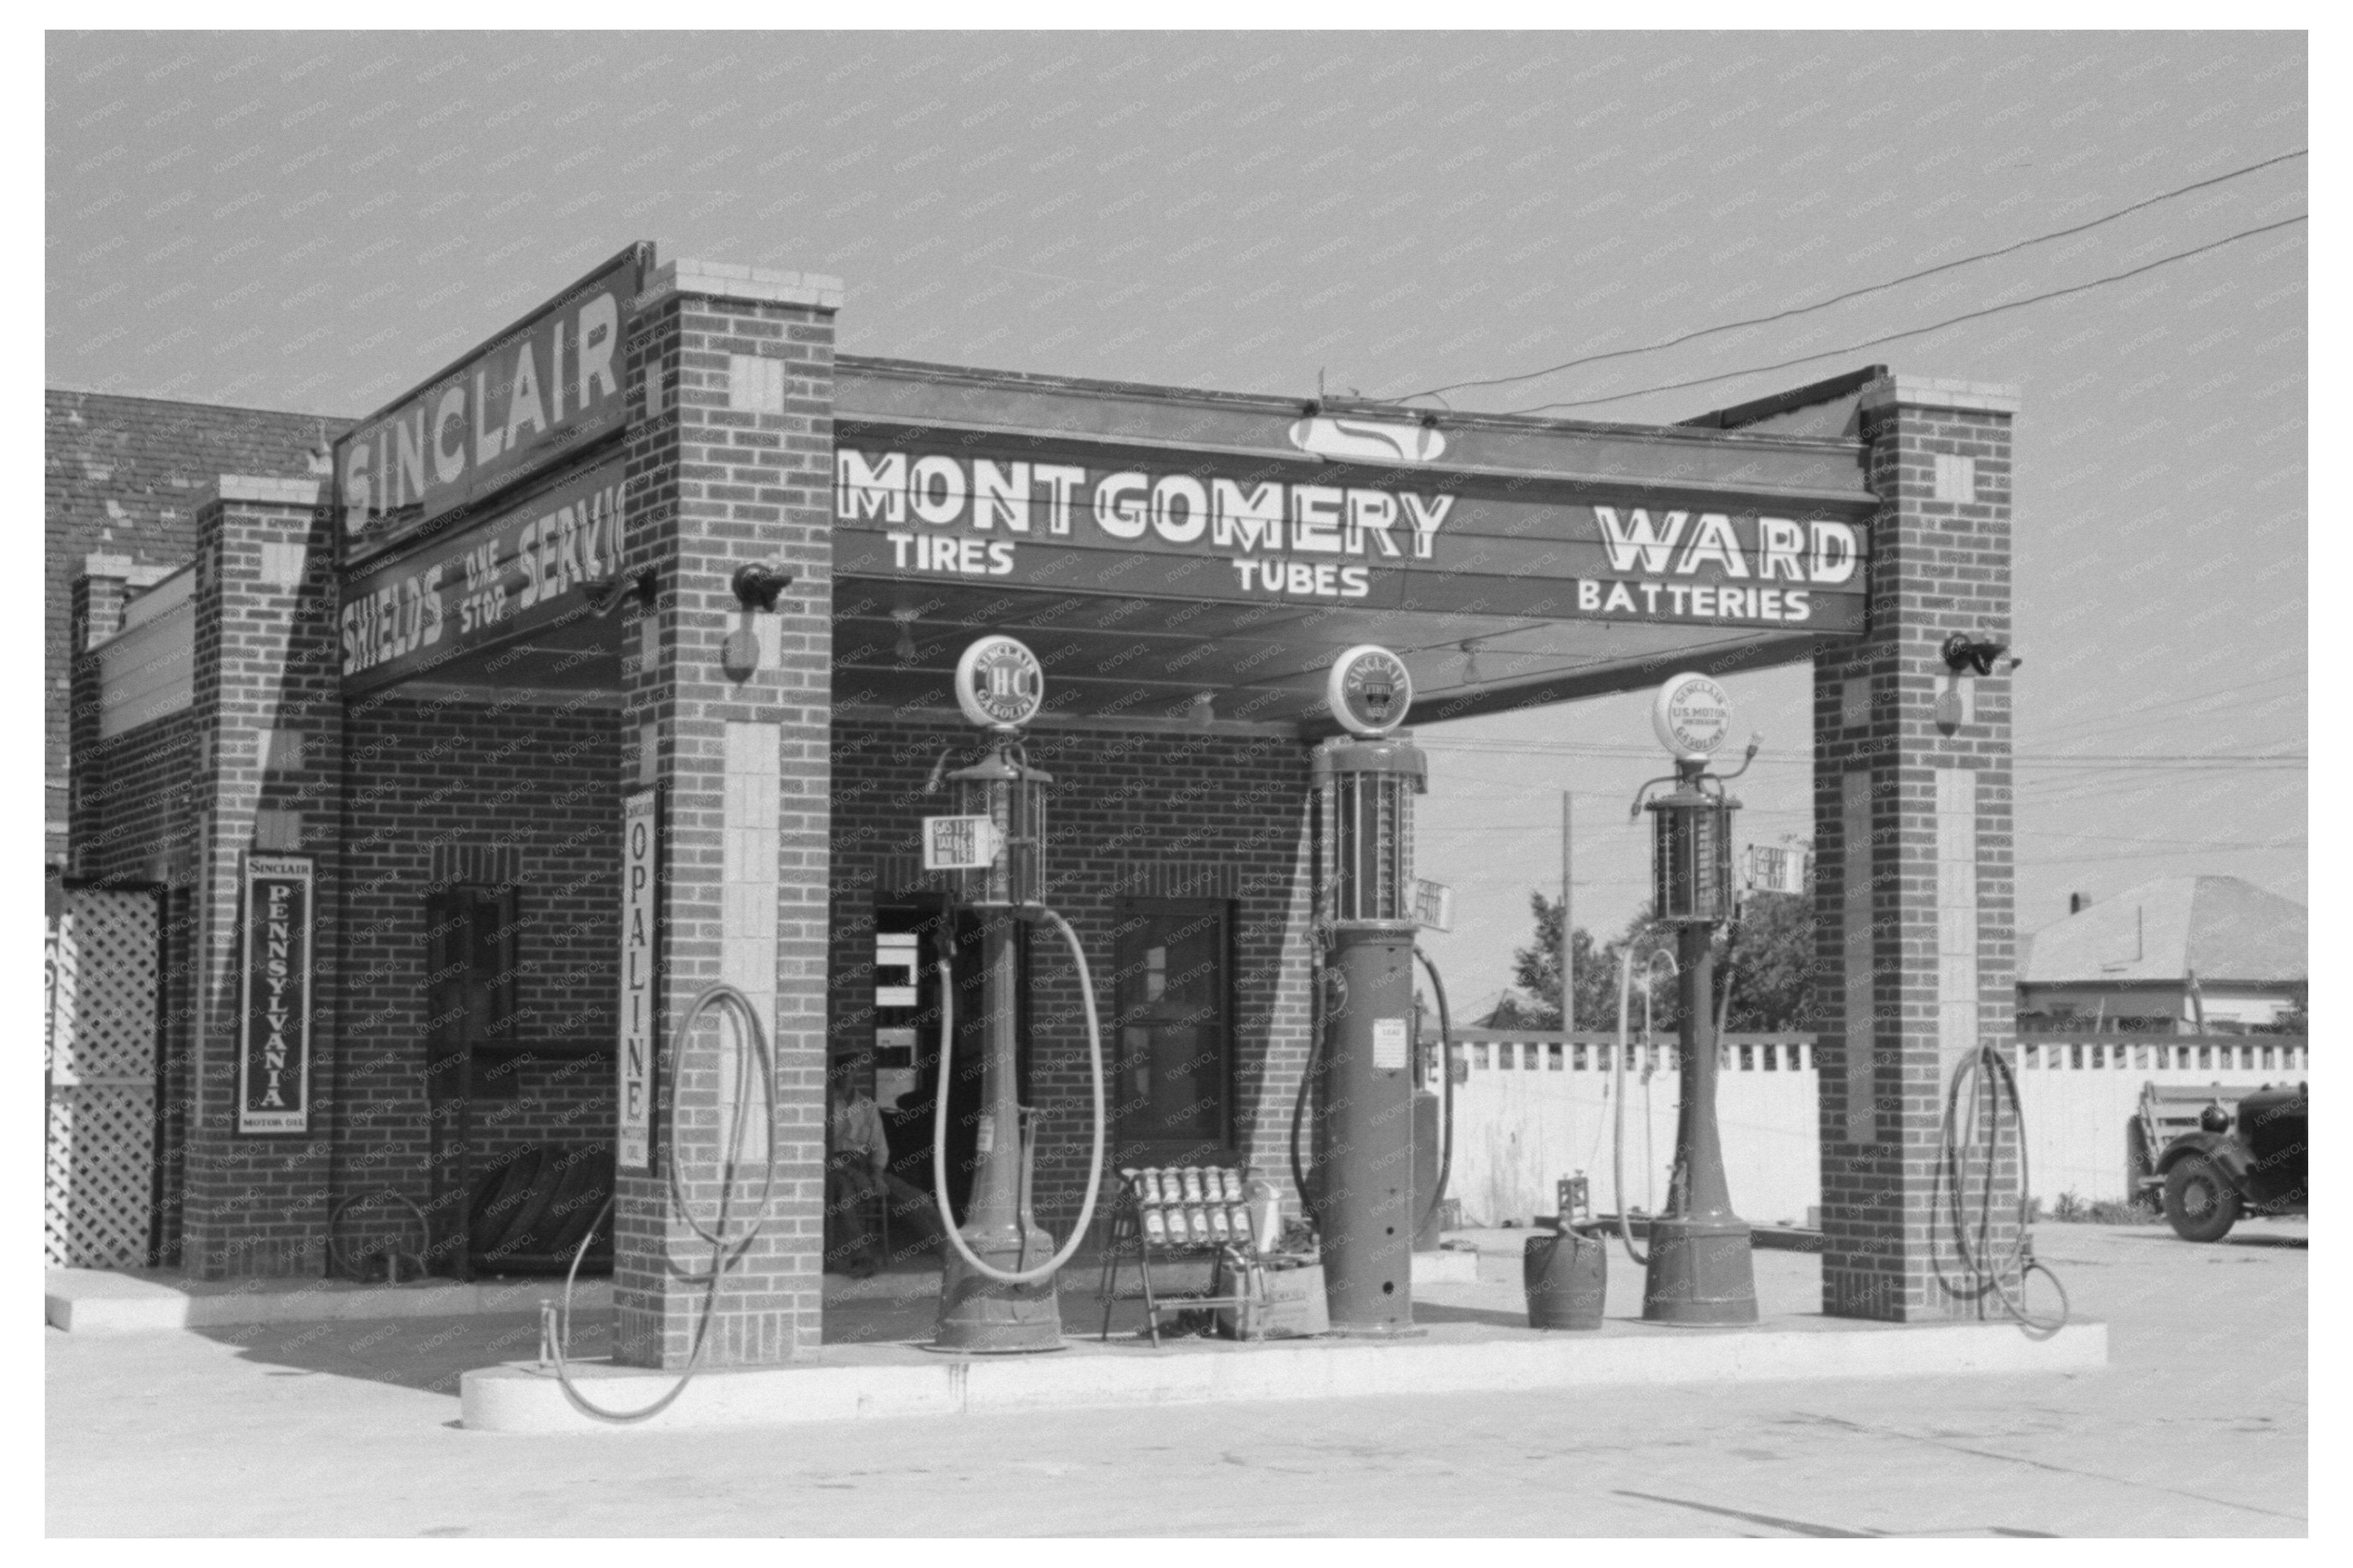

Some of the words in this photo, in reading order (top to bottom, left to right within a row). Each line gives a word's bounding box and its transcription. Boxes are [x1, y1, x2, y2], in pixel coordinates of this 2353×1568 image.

[346, 291, 618, 534] SINCLAIR
[838, 448, 1454, 558] MONTGOMERY
[1594, 505, 1856, 583] WARD
[887, 533, 1015, 575] TIRES
[1233, 559, 1369, 598] TUBES
[342, 564, 443, 676] SHIELDS
[466, 539, 499, 592] ONE
[461, 585, 506, 634] STOP
[1578, 579, 1810, 620] BATTERIES
[977, 644, 1036, 673] SINCLAIR
[1348, 657, 1405, 691] SINCLAIR
[976, 688, 1037, 719] GASOLINE
[1676, 683, 1724, 704] SINCLAIR
[1676, 726, 1724, 749] GASOLINE
[249, 860, 309, 875] SINCLAIR
[627, 822, 647, 1119] OPALINE
[261, 885, 289, 1107] PENNSYLVANIA
[243, 1118, 283, 1127] MOTOR
